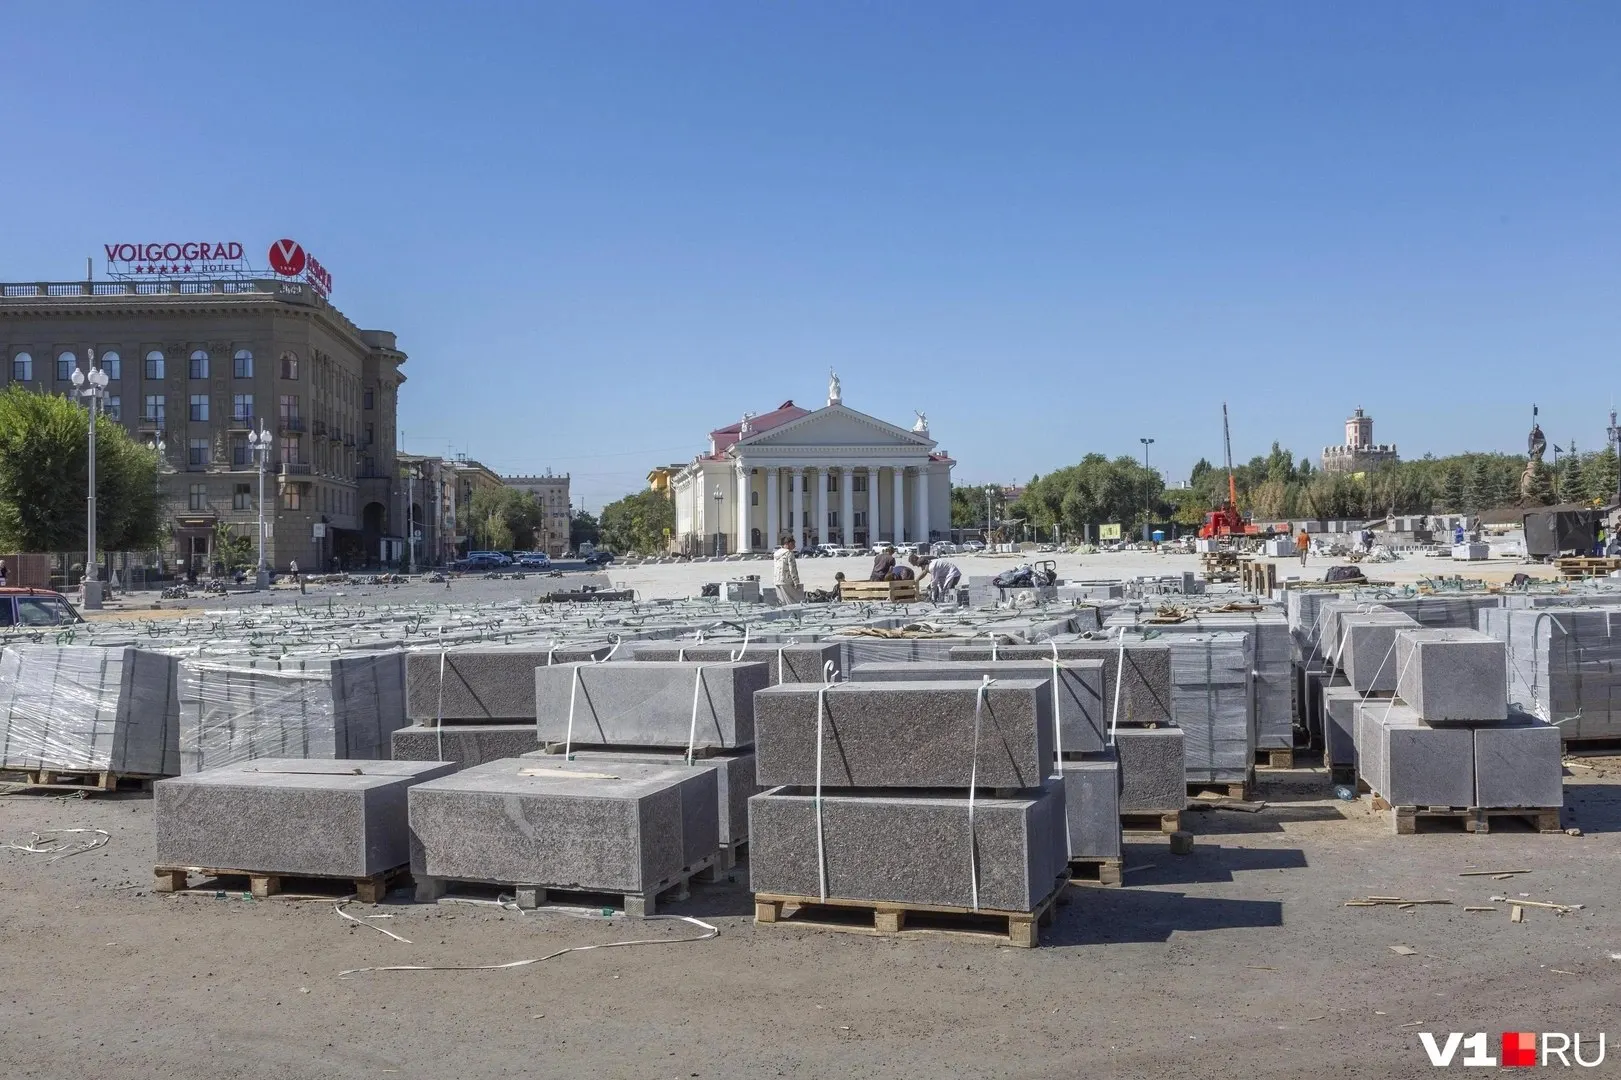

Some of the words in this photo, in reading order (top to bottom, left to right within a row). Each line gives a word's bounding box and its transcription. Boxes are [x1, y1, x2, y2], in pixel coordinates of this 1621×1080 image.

[104, 242, 243, 262] VOLGOGRAD
[276, 239, 298, 264] V
[202, 264, 236, 272] HOTEL
